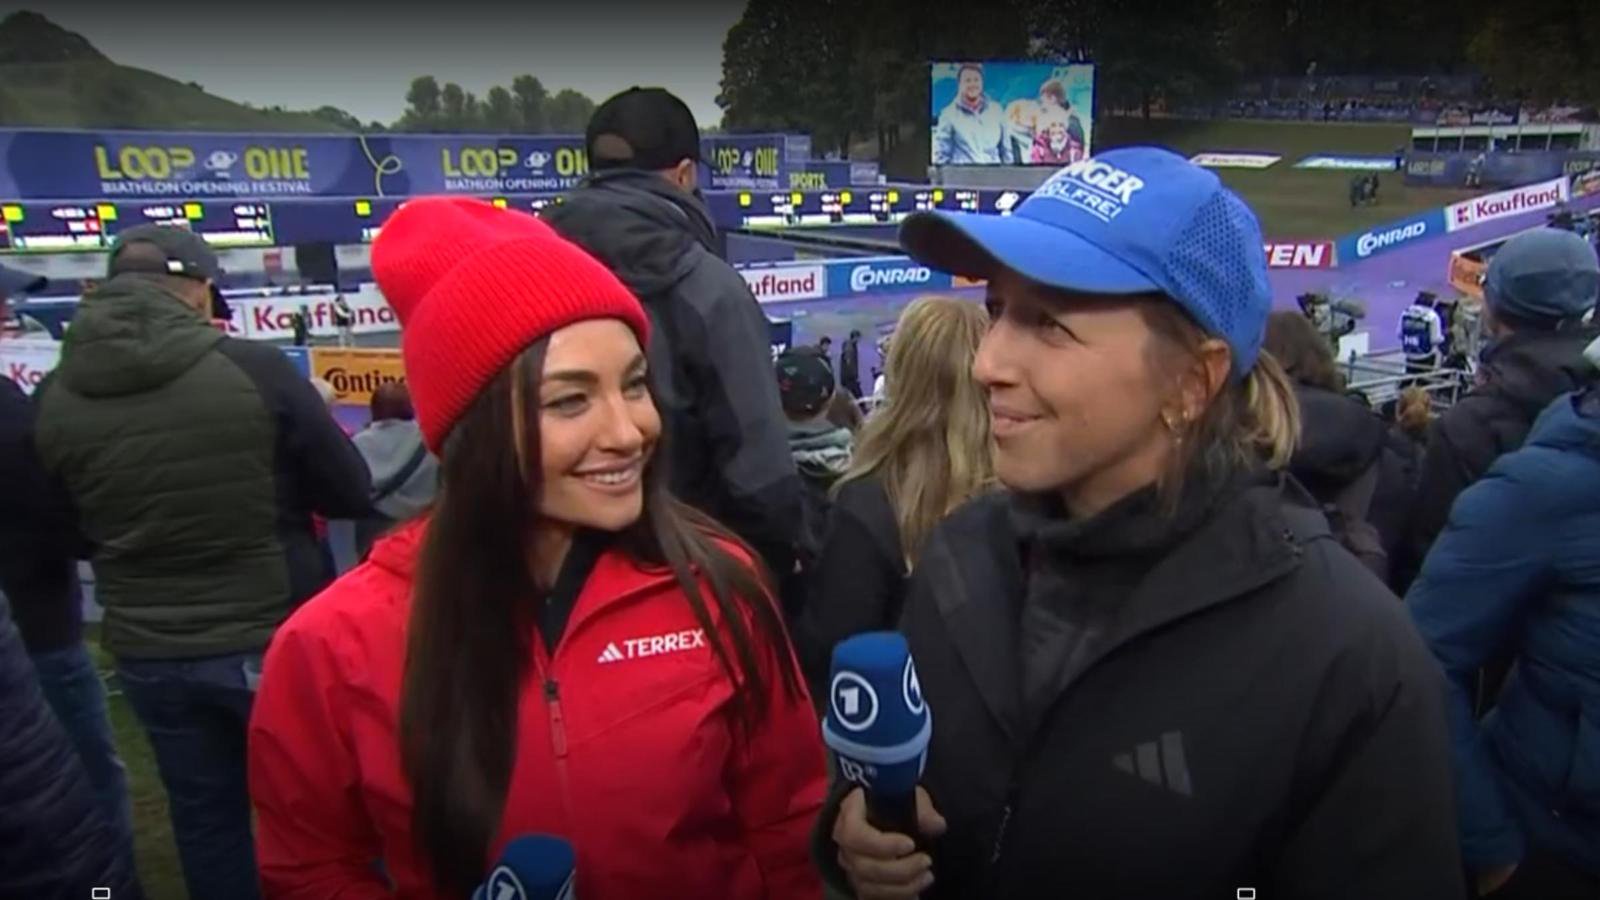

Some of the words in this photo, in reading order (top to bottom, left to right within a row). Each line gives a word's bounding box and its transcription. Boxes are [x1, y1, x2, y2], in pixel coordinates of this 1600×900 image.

[95, 146, 195, 179] LOOP
[443, 148, 518, 177] LOOP
[102, 181, 179, 193] BIATHLON
[182, 181, 249, 193] OPENING
[252, 180, 312, 193] FESTIVAL
[445, 178, 503, 190] BIATHLON
[505, 178, 557, 190] OPENING
[1476, 184, 1561, 218] Kaufland
[1357, 221, 1426, 257] CONRAD
[1264, 244, 1324, 267] EN
[851, 264, 931, 292] CONRAD
[9, 362, 44, 387] Ka
[624, 628, 705, 659] TERREX
[839, 686, 860, 715] 1
